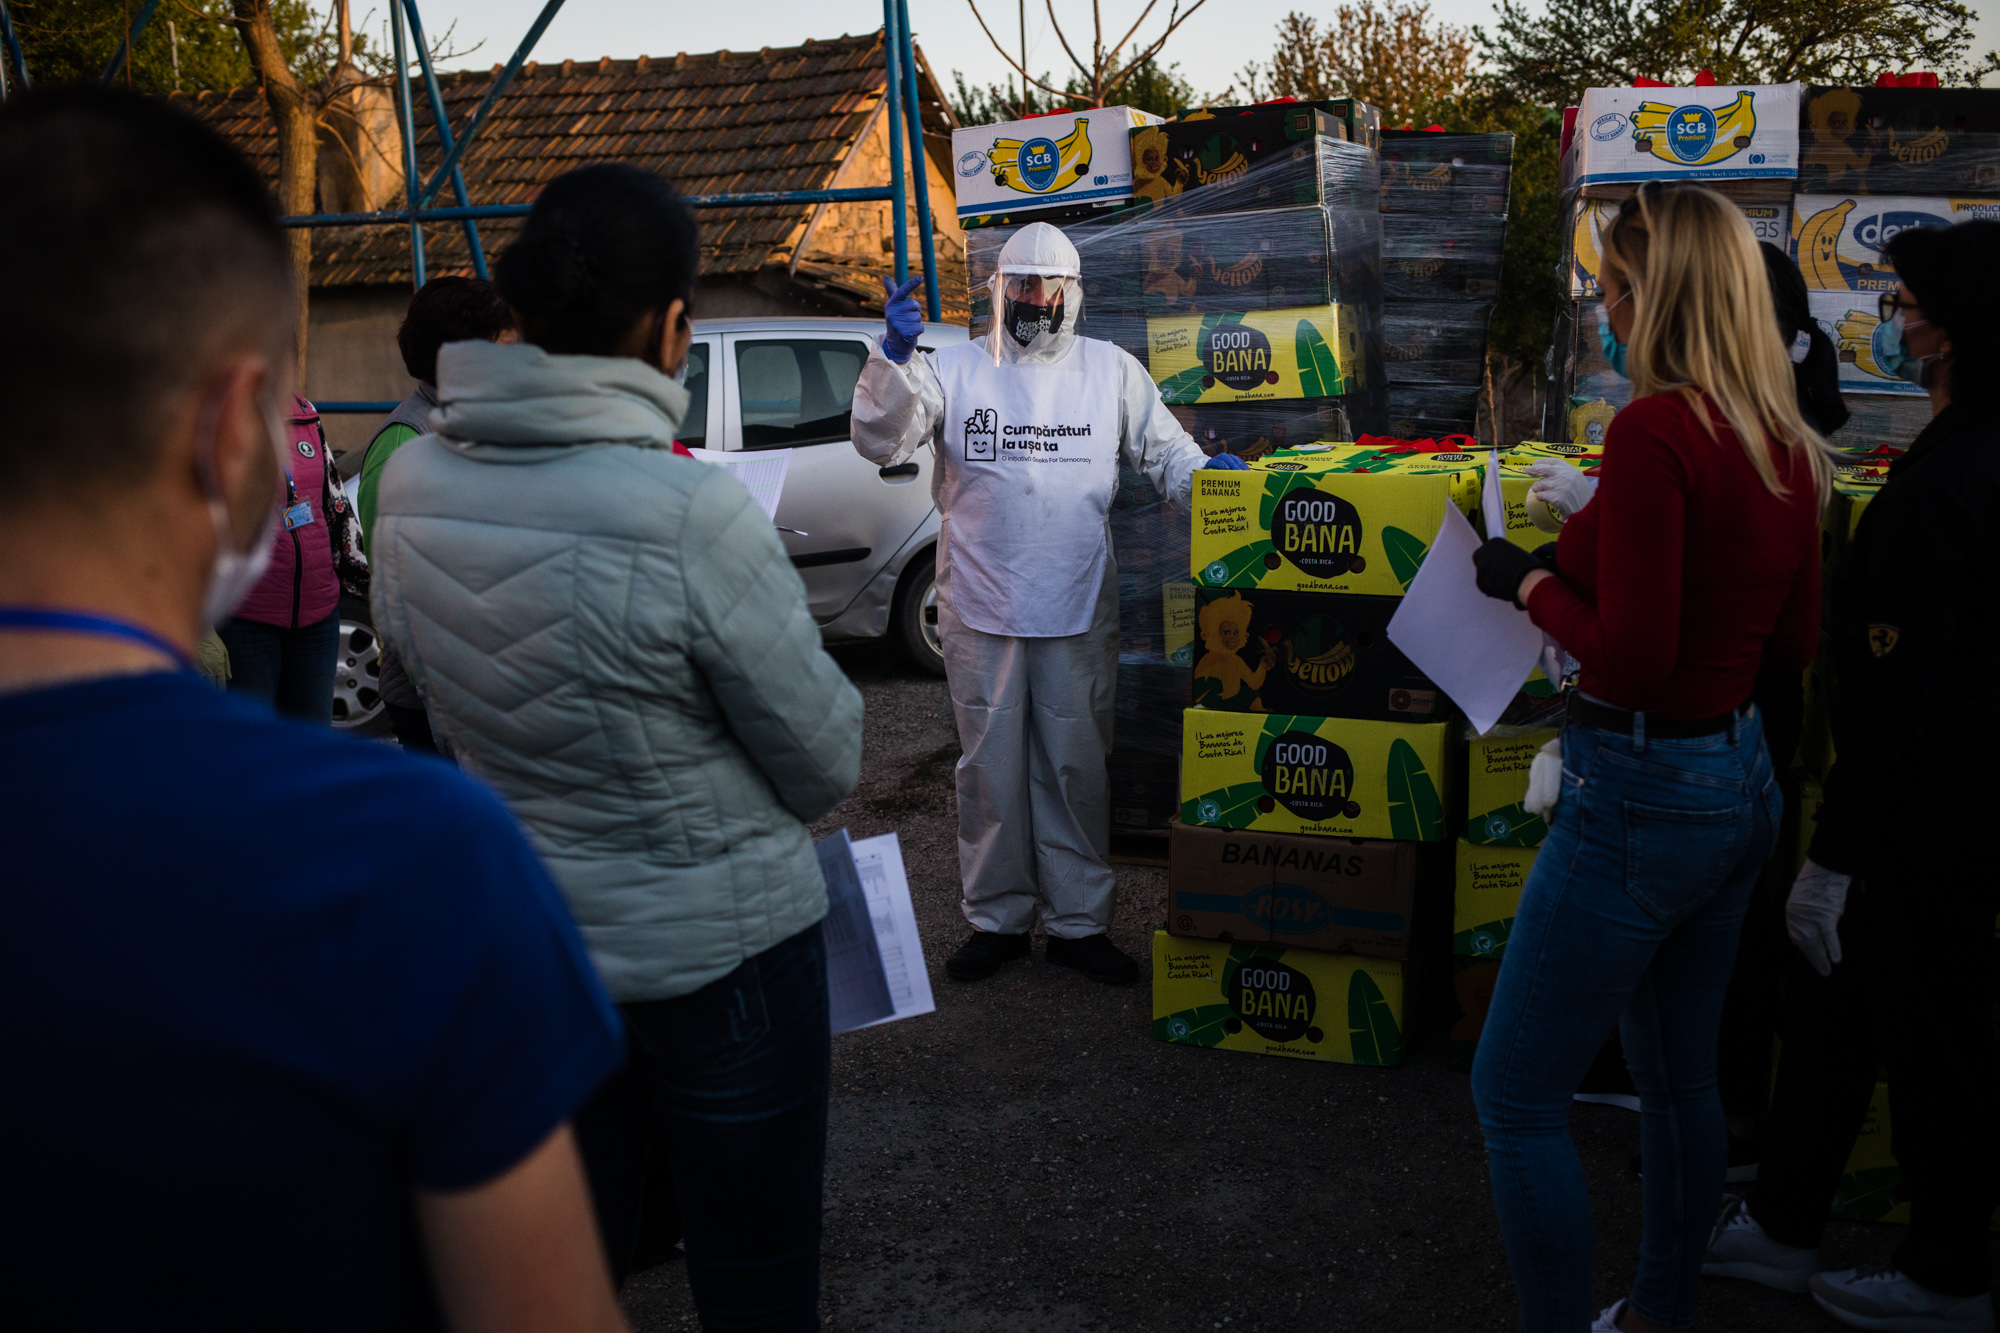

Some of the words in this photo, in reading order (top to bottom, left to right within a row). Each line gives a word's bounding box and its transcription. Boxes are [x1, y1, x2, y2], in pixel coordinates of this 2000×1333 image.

[1676, 122, 1707, 135] SCB
[1677, 134, 1706, 142] Premium
[1887, 127, 1949, 164] yellow
[1026, 153, 1052, 166] SCB
[1028, 164, 1052, 173] Premium
[1193, 157, 1249, 189] yellow
[1742, 208, 1773, 217] MIUM
[1208, 255, 1263, 287] yellow
[1856, 279, 1900, 291] PREM
[1211, 332, 1250, 350] GOOD
[1155, 346, 1173, 354] Costa
[1213, 348, 1267, 373] BANA
[1235, 391, 1275, 400] goodbana.com
[1003, 424, 1091, 439] Cumpărături
[1002, 438, 1016, 450] la
[1018, 440, 1041, 454] ușa
[1043, 441, 1058, 452] ta
[1201, 479, 1241, 488] PREMIUM
[1201, 487, 1241, 497] BANANAS
[1219, 506, 1247, 518] mejores
[1284, 500, 1336, 523] GOOD
[1203, 517, 1235, 526] Bananos
[1507, 519, 1535, 530] Costa
[1203, 526, 1227, 536] Costa
[1227, 522, 1250, 532] Rica!
[1284, 522, 1355, 554] BANA
[1297, 580, 1349, 591] goodbana.com
[1284, 640, 1356, 684] yellow
[1215, 731, 1244, 741] mejores
[1198, 741, 1231, 750] Bananos
[1504, 744, 1535, 754] mejores
[1198, 750, 1223, 759] Costa
[1224, 746, 1246, 756] Rica!
[1275, 742, 1328, 767] GOOD
[1486, 755, 1521, 764] Bananos
[1523, 752, 1535, 760] de
[1485, 764, 1513, 773] Costa
[1275, 765, 1346, 798] BANA
[1300, 823, 1354, 834] goodbana.com
[1221, 842, 1364, 877] BANANAS
[1491, 862, 1521, 871] mejores
[1472, 871, 1507, 880] Bananos
[1472, 881, 1499, 889] Costa
[1499, 878, 1523, 888] Rica!
[1255, 894, 1323, 923] ROSY
[1183, 954, 1211, 963] mejores
[1167, 962, 1199, 971] Bananos
[1167, 971, 1191, 979] Costa
[1241, 967, 1291, 991] GOOD
[1241, 988, 1309, 1022] BANA
[1265, 1044, 1316, 1056] goodbana.com
